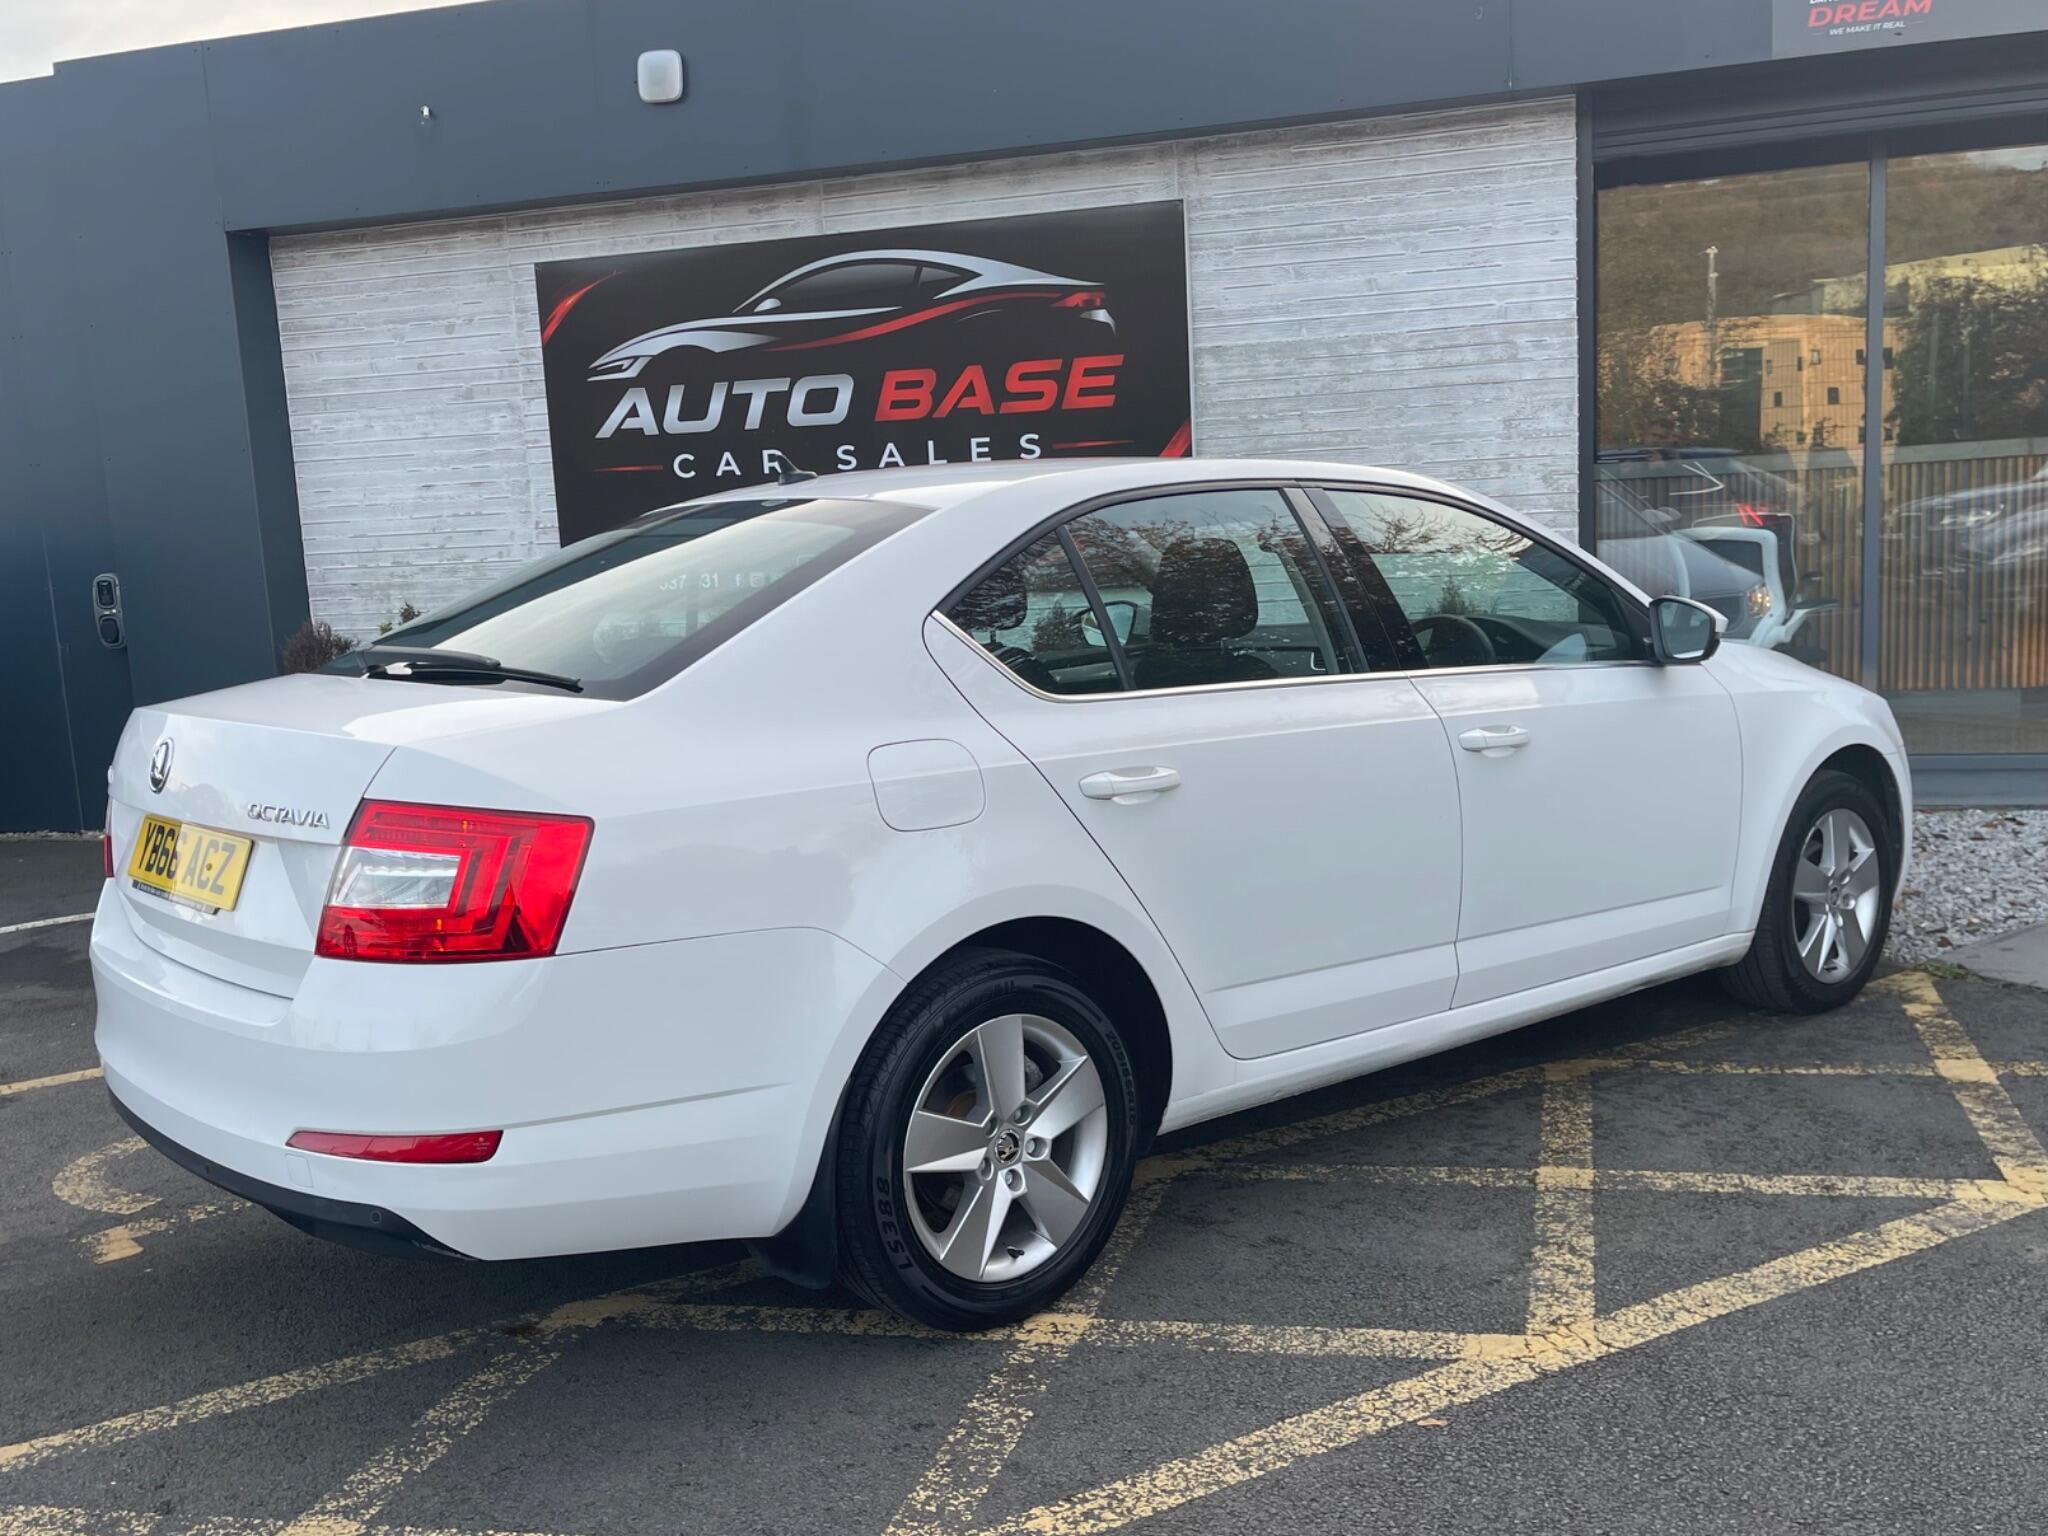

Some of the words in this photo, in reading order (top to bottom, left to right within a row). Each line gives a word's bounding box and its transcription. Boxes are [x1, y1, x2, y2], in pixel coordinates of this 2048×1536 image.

[1808, 0, 1934, 28] DREAM
[1829, 27, 1845, 36] WE
[1846, 24, 1872, 34] MAKE
[1873, 22, 1882, 32] IT
[1883, 20, 1906, 30] REAL
[595, 373, 854, 439] AUTO
[875, 354, 1124, 422] BASE
[672, 449, 784, 479] CAR
[837, 433, 1042, 472] SALES
[247, 803, 330, 829] OCTAVIA
[182, 836, 237, 895] ACZ
[877, 1177, 914, 1270] LS388
